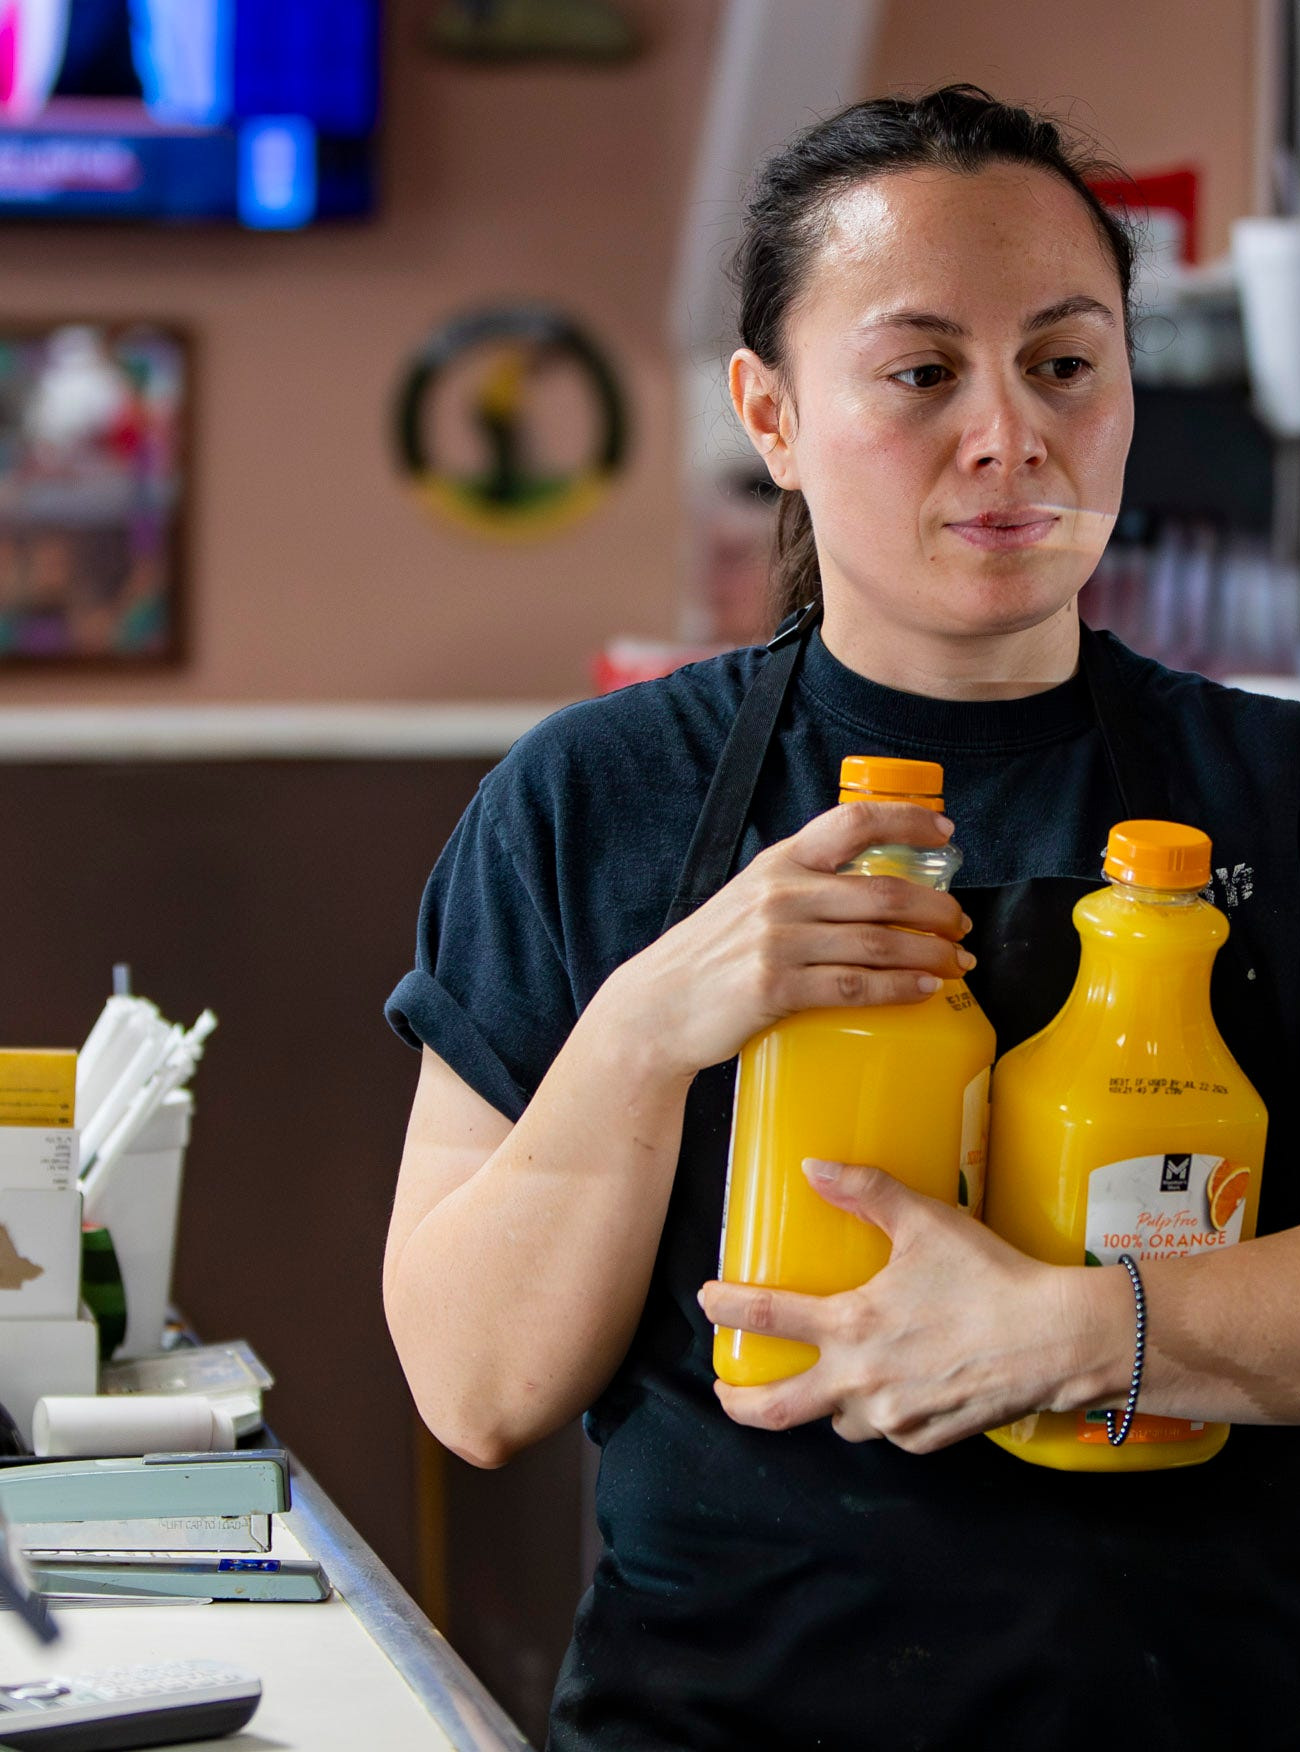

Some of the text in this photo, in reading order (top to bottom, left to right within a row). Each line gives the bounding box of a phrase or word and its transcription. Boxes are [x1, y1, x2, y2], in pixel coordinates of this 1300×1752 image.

[1136, 1211, 1172, 1232] Pulp
[1103, 1230, 1228, 1249] 100% ORANGE
